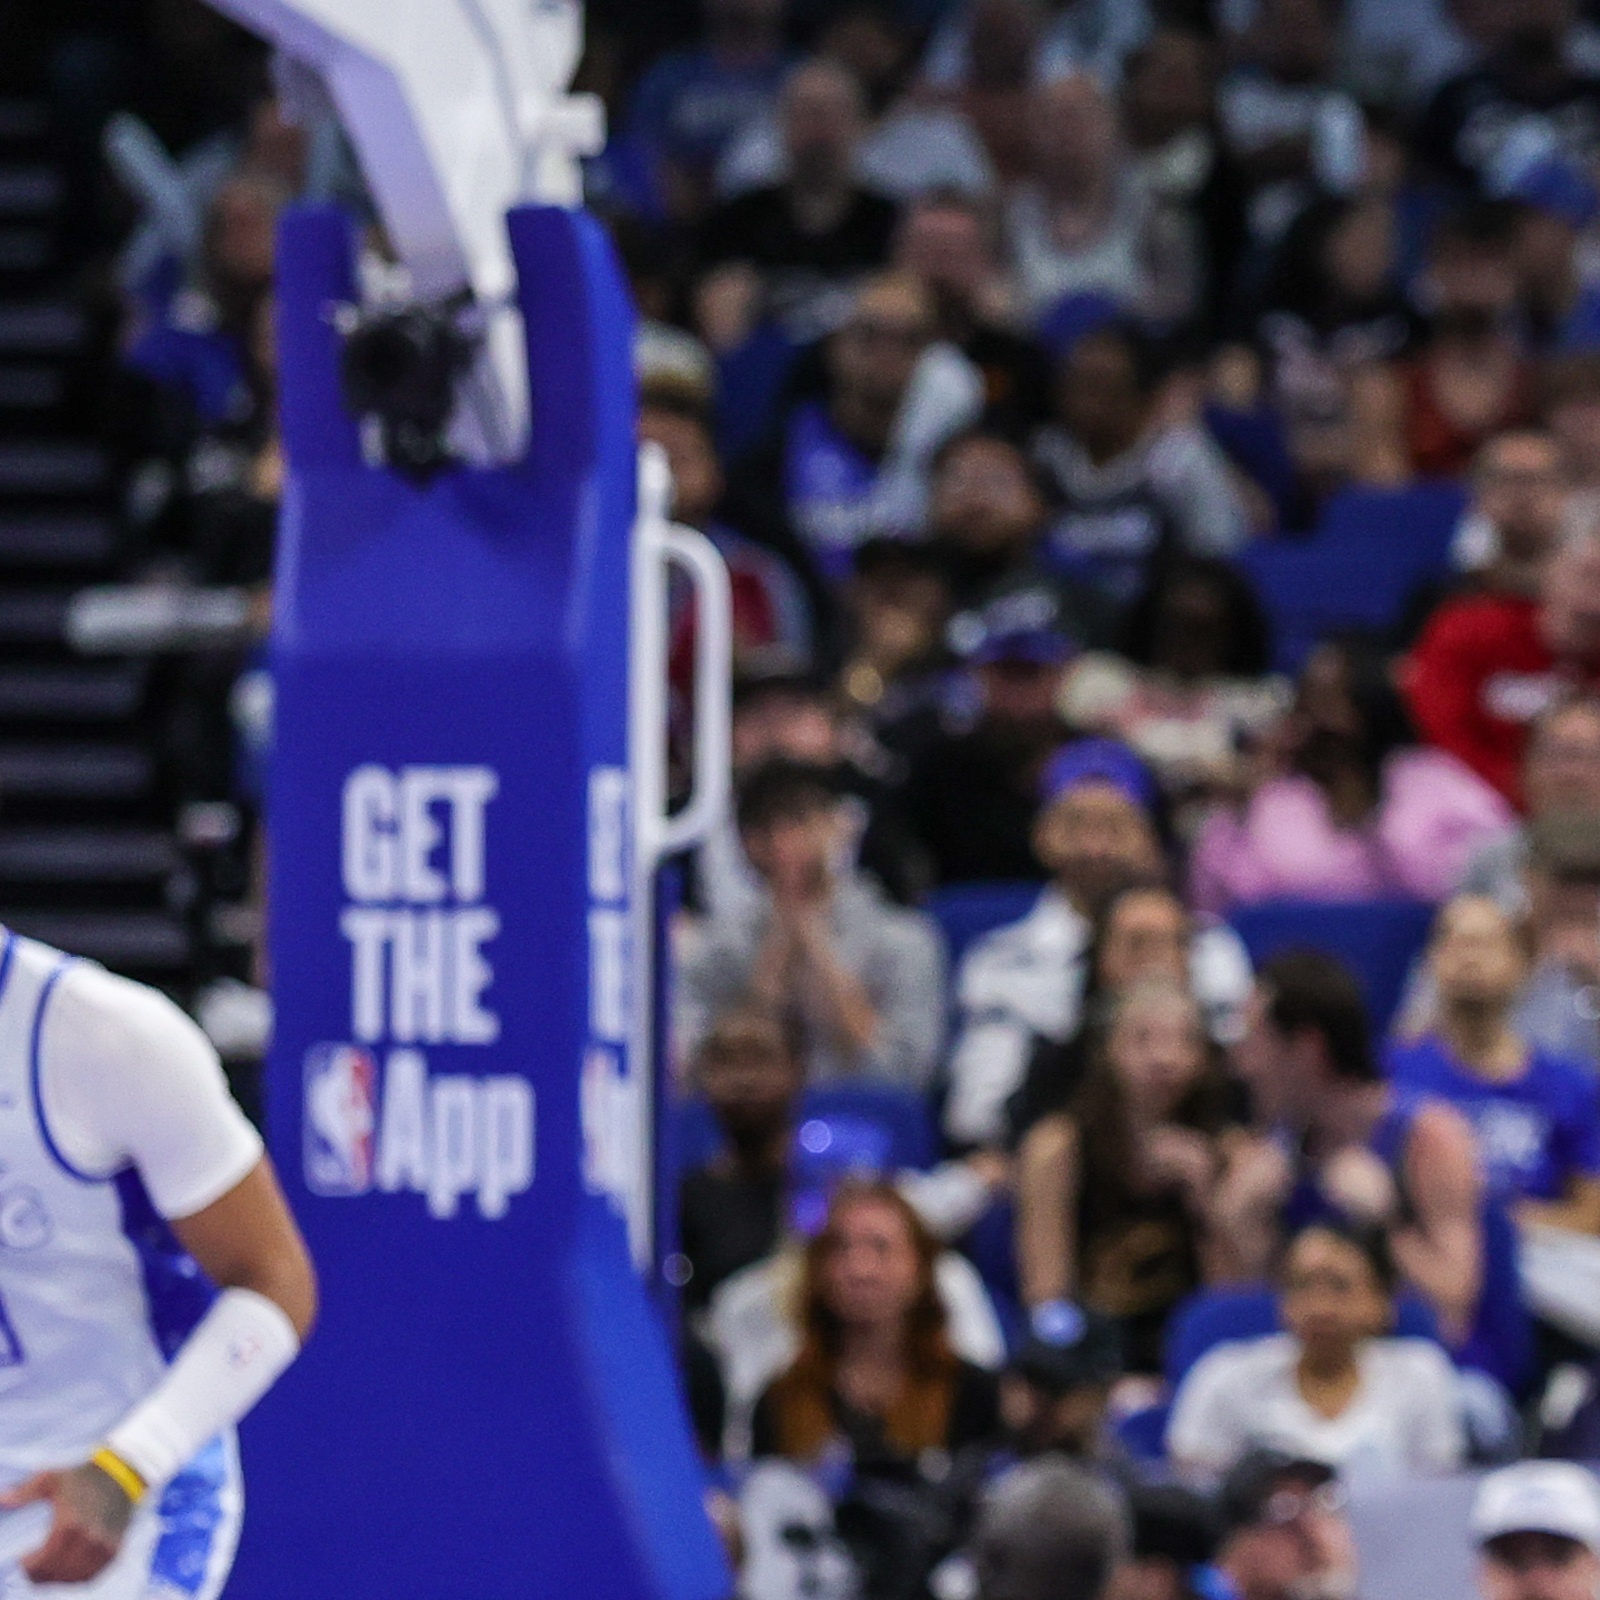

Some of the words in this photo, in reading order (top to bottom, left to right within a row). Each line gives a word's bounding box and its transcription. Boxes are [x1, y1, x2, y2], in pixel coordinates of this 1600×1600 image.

[341, 764, 500, 903] GET
[340, 908, 502, 1046] THE
[374, 1046, 538, 1222] App
